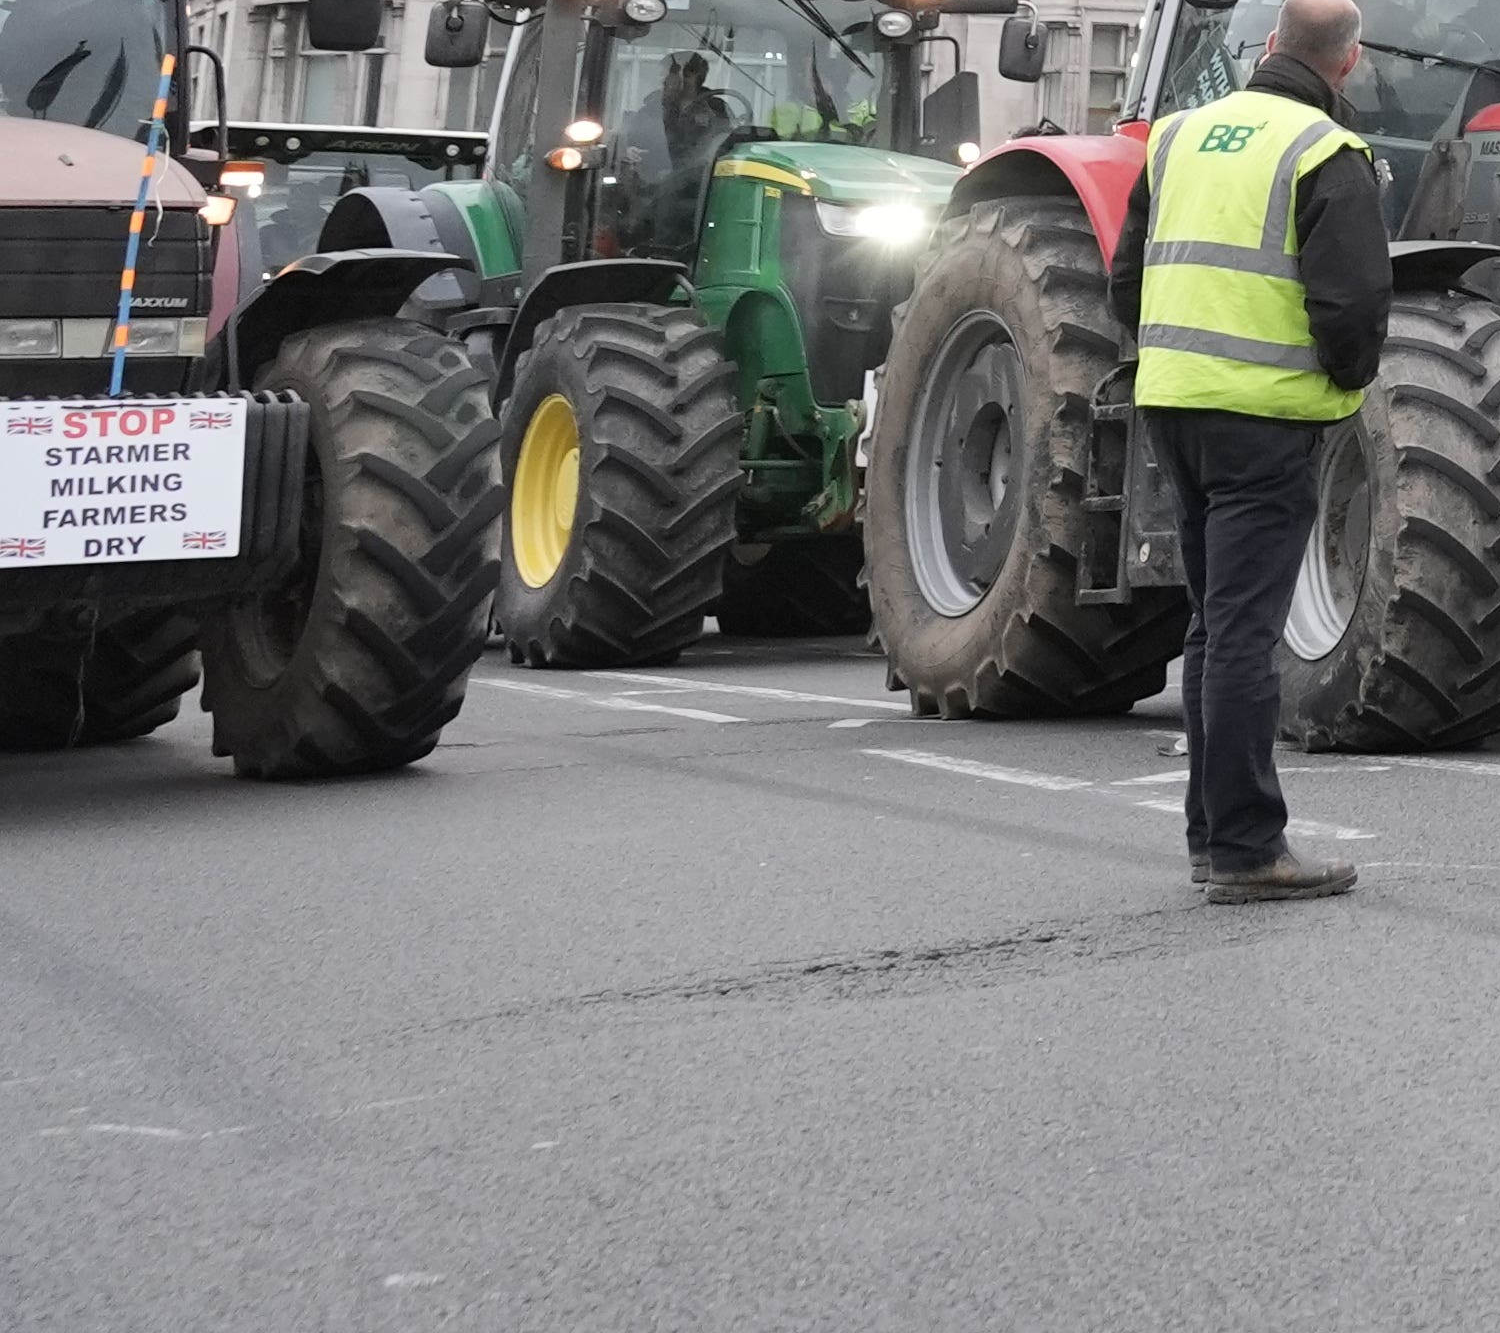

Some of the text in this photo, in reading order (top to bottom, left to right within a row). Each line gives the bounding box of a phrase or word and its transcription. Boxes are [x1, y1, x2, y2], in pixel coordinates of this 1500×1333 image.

[63, 408, 176, 439] STOP
[45, 443, 191, 466] STARMER
[50, 473, 183, 497] MILKING
[42, 503, 187, 529] FARMERS
[84, 535, 146, 559] DRY
